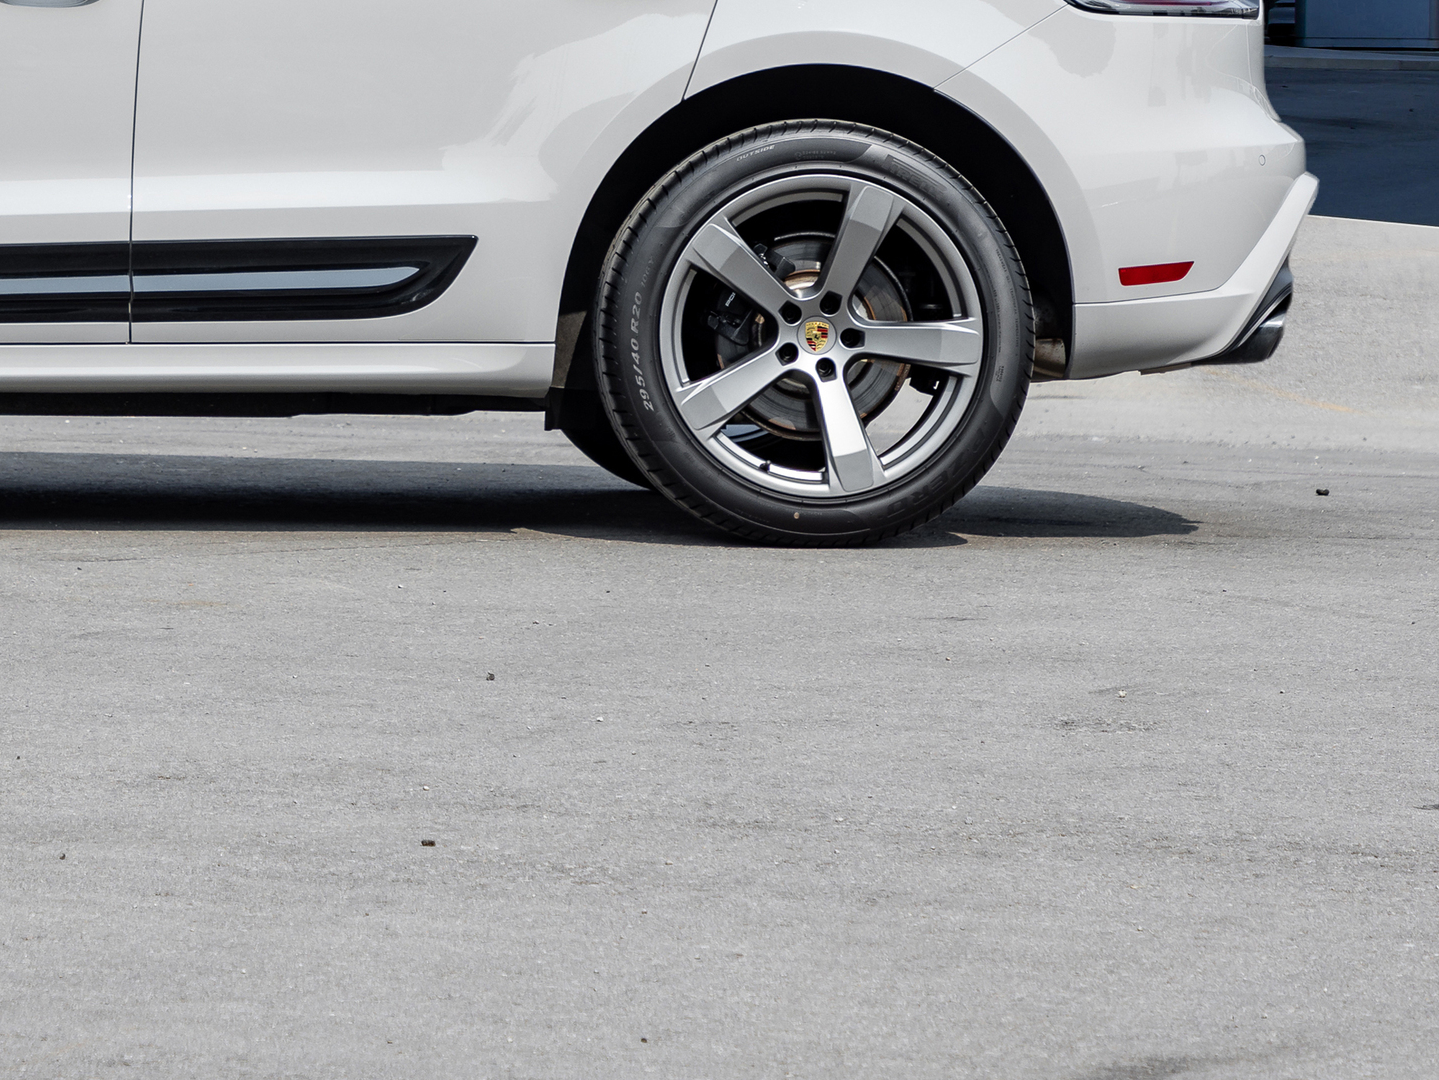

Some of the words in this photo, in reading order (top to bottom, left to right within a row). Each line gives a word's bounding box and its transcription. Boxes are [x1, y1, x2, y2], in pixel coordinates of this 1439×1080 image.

[736, 144, 776, 162] OUTSIDE
[630, 290, 643, 334] R20
[630, 337, 654, 412] 295/40
